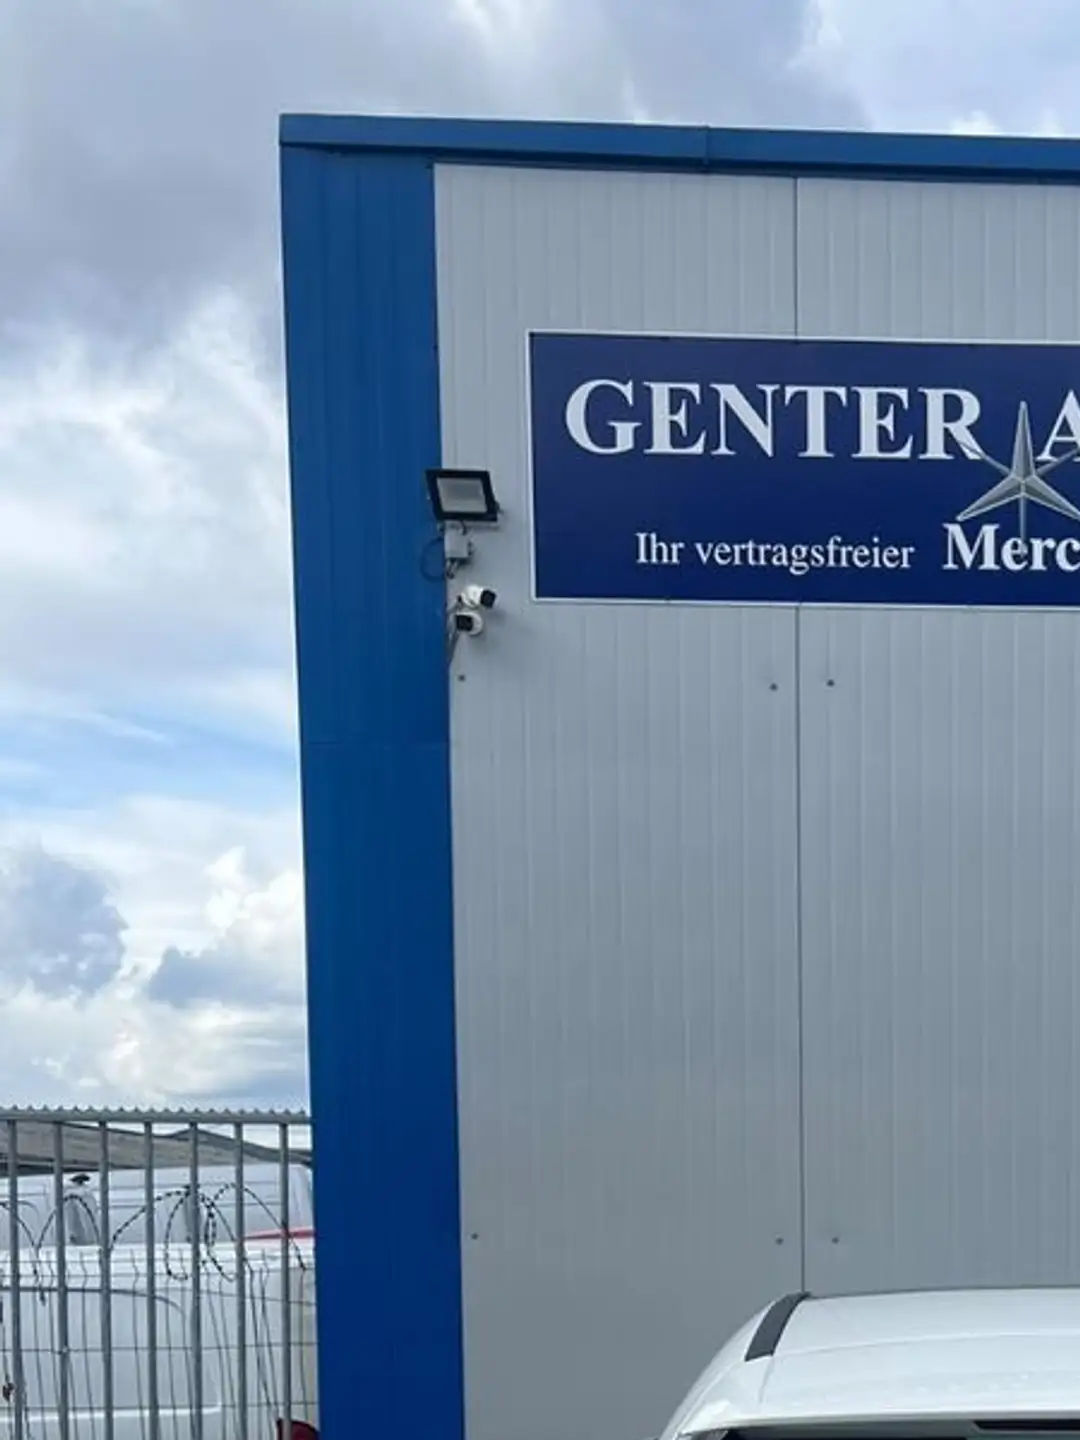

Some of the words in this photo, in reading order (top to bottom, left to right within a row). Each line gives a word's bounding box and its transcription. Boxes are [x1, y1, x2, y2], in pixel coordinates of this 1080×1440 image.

[564, 377, 984, 461] GENTER
[635, 532, 685, 566] Ihr
[696, 535, 916, 575] vertragsfreier
